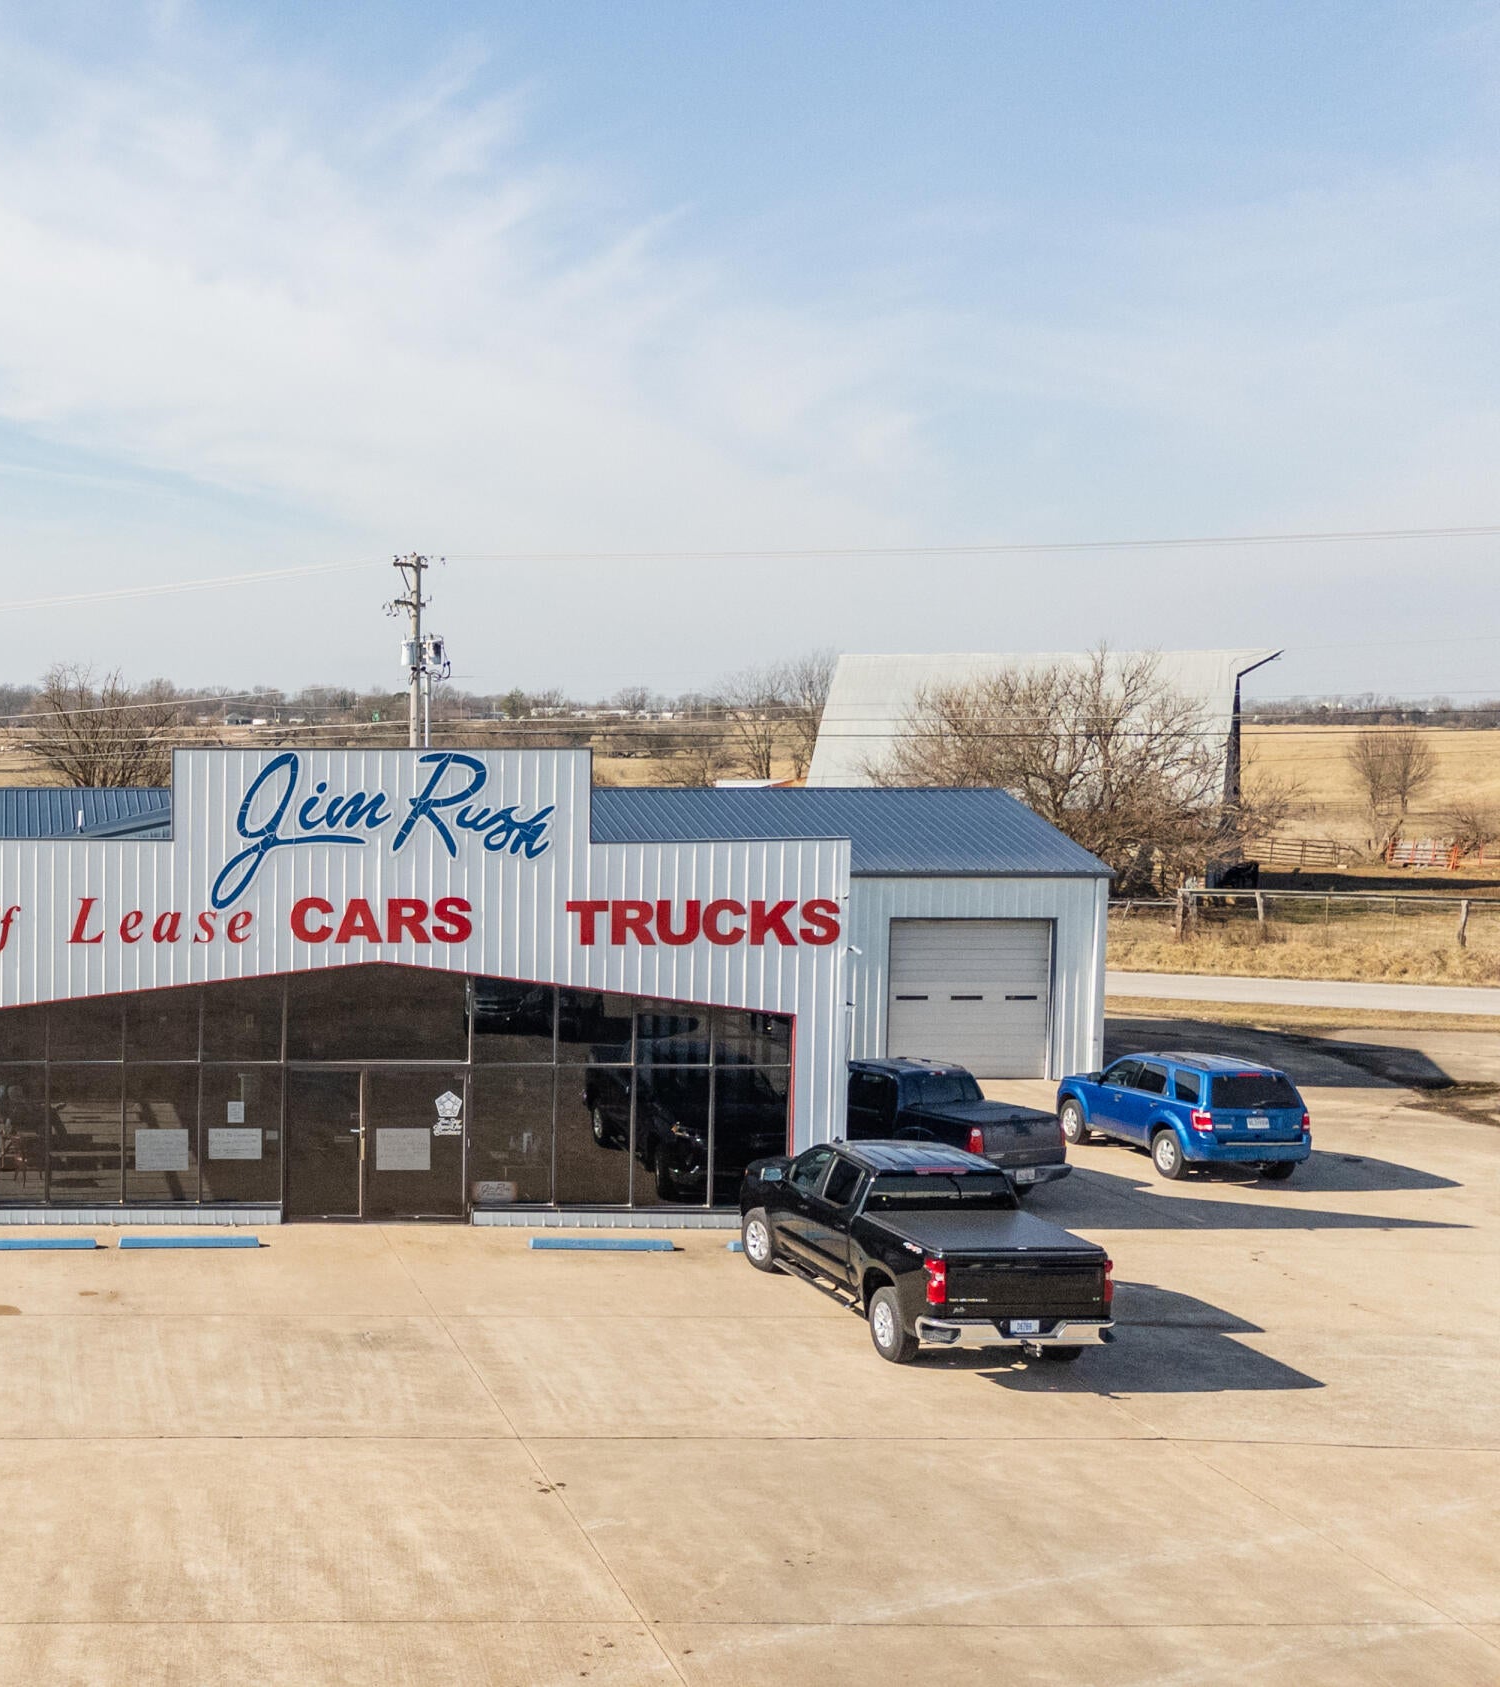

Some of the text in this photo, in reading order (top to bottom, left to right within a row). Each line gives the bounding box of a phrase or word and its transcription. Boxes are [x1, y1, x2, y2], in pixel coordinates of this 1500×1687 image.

[211, 752, 556, 909] Jim Rush
[69, 897, 253, 944] Lease
[289, 896, 472, 944] CARS
[565, 898, 840, 946] TRUCKS
